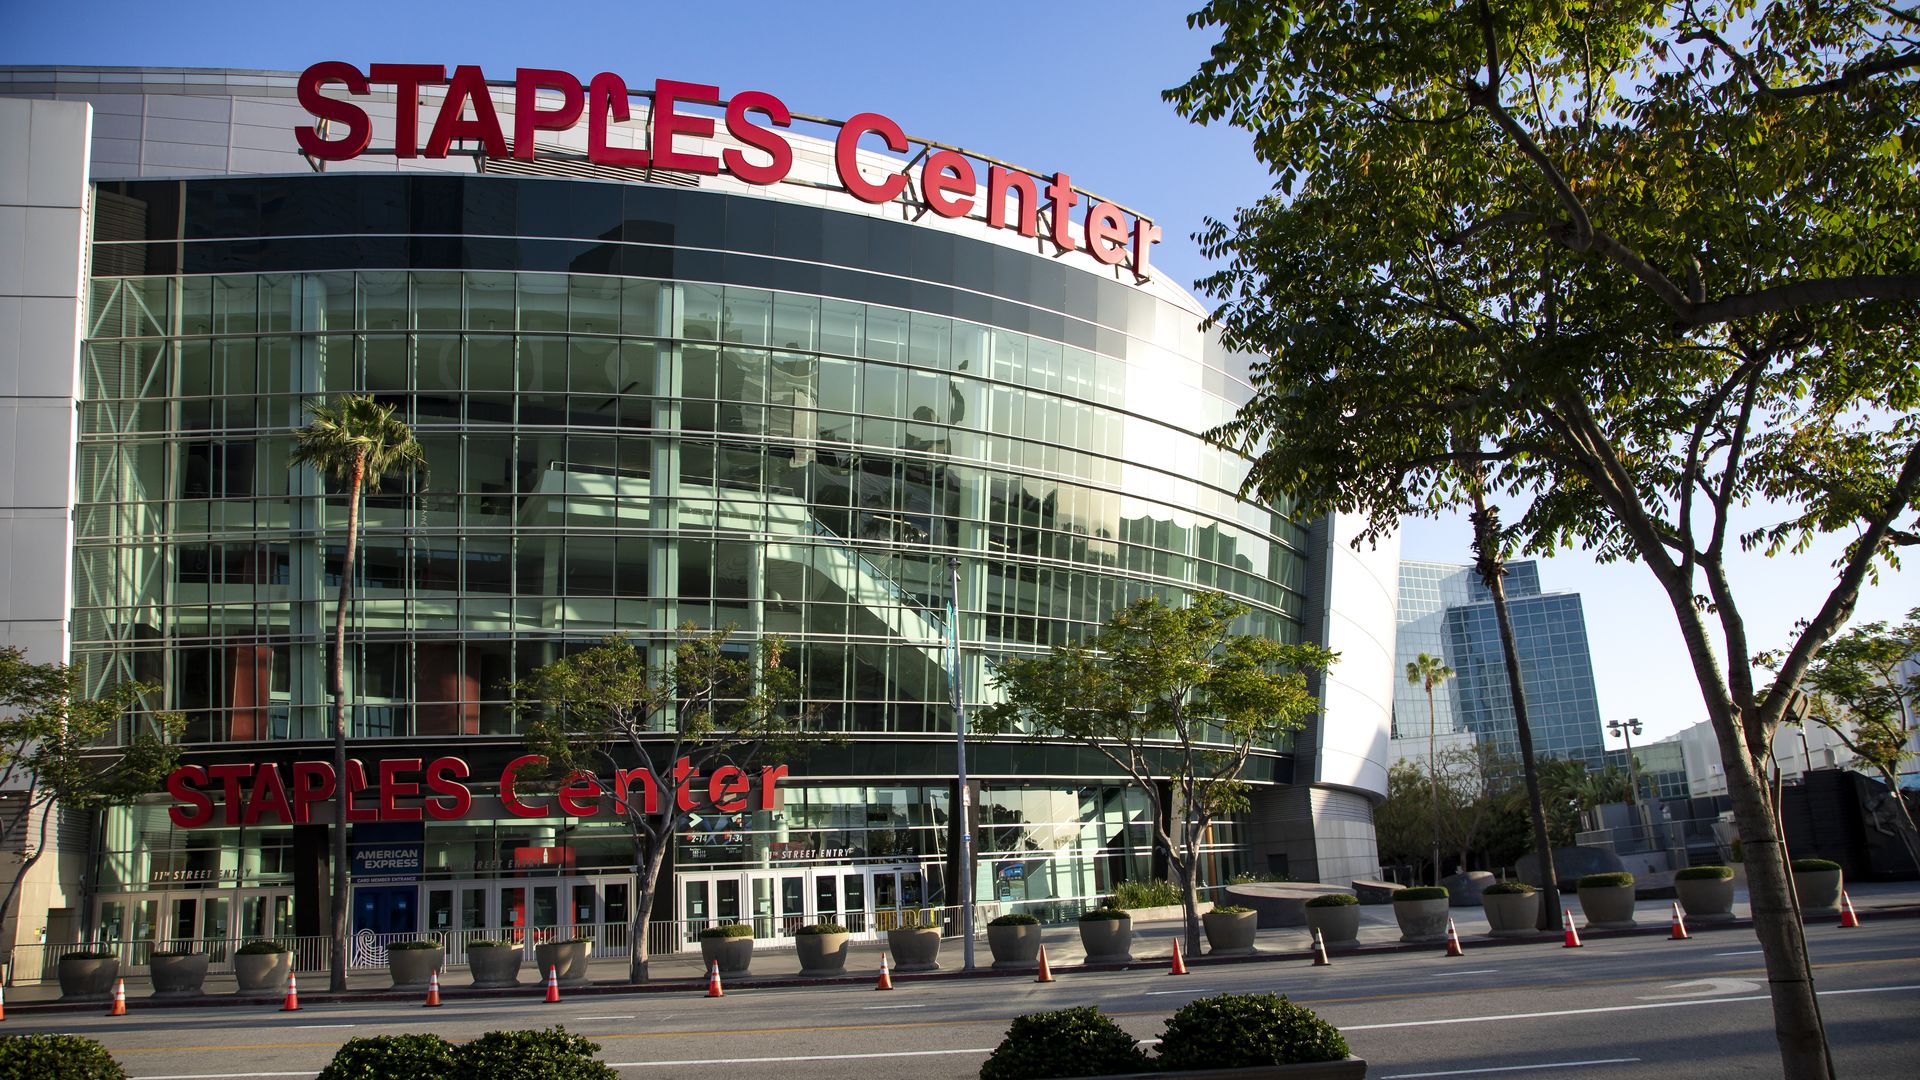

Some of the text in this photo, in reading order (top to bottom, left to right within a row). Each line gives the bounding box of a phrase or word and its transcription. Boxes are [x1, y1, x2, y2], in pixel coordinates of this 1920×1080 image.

[294, 60, 1162, 279] STAPLES Center
[167, 753, 789, 828] STAPLES Center
[356, 849, 418, 860] AMERICAN
[781, 849, 816, 860] STREET
[820, 848, 849, 858] ENTRY
[364, 858, 418, 869] EXPRESS
[173, 869, 212, 880] STREET
